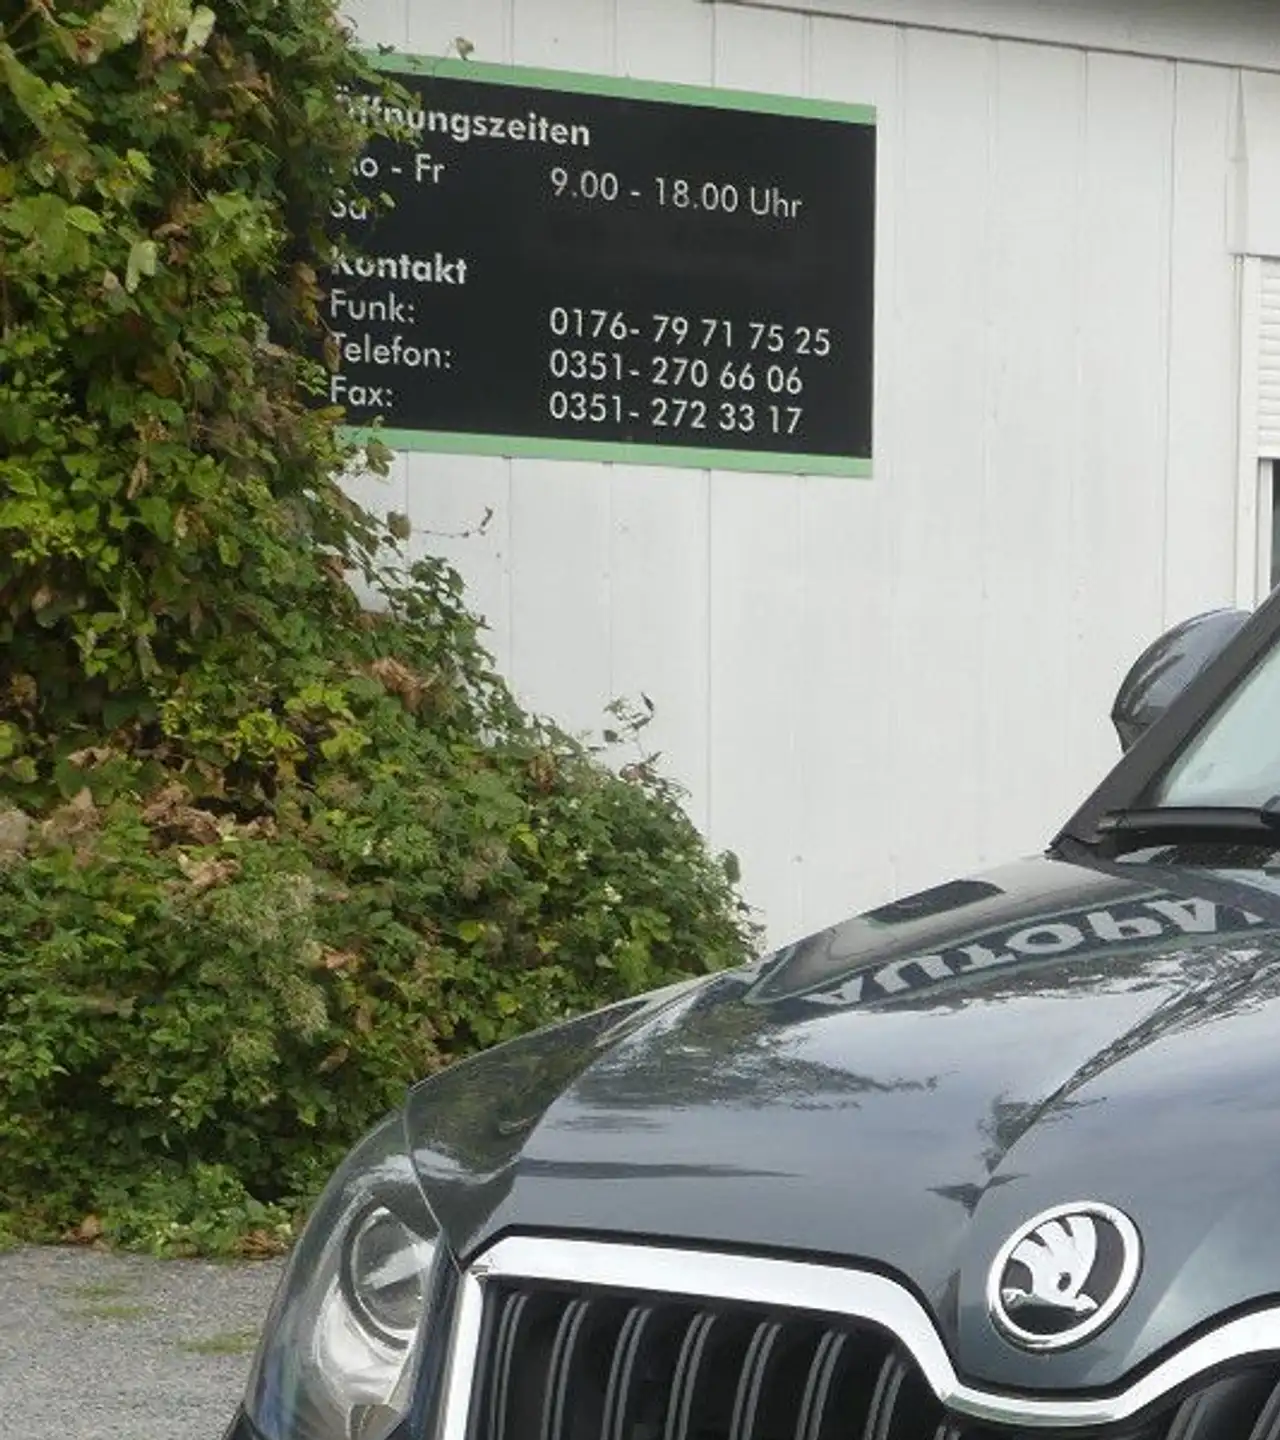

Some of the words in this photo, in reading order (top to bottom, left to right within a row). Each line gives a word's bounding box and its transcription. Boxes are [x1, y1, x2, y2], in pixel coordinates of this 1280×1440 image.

[415, 153, 446, 184] Fr
[550, 167, 619, 201] 9.00
[655, 176, 739, 213] 18.00
[750, 186, 803, 218] Uhr
[330, 246, 468, 285] Kontakt
[330, 288, 415, 325] Funk:
[550, 307, 640, 340] 0176-
[652, 314, 689, 346] 79
[702, 318, 733, 348] 71
[749, 322, 784, 353] 75
[795, 326, 831, 357] 25
[331, 331, 452, 369] Telefon:
[550, 349, 640, 382] 0351-
[652, 356, 709, 388] 270
[719, 361, 756, 391] 66
[767, 364, 803, 395] 06
[330, 374, 393, 407] Fax:
[550, 390, 640, 424] 0351-
[651, 397, 707, 430] 272
[719, 402, 756, 433] 33
[769, 404, 803, 435] 17
